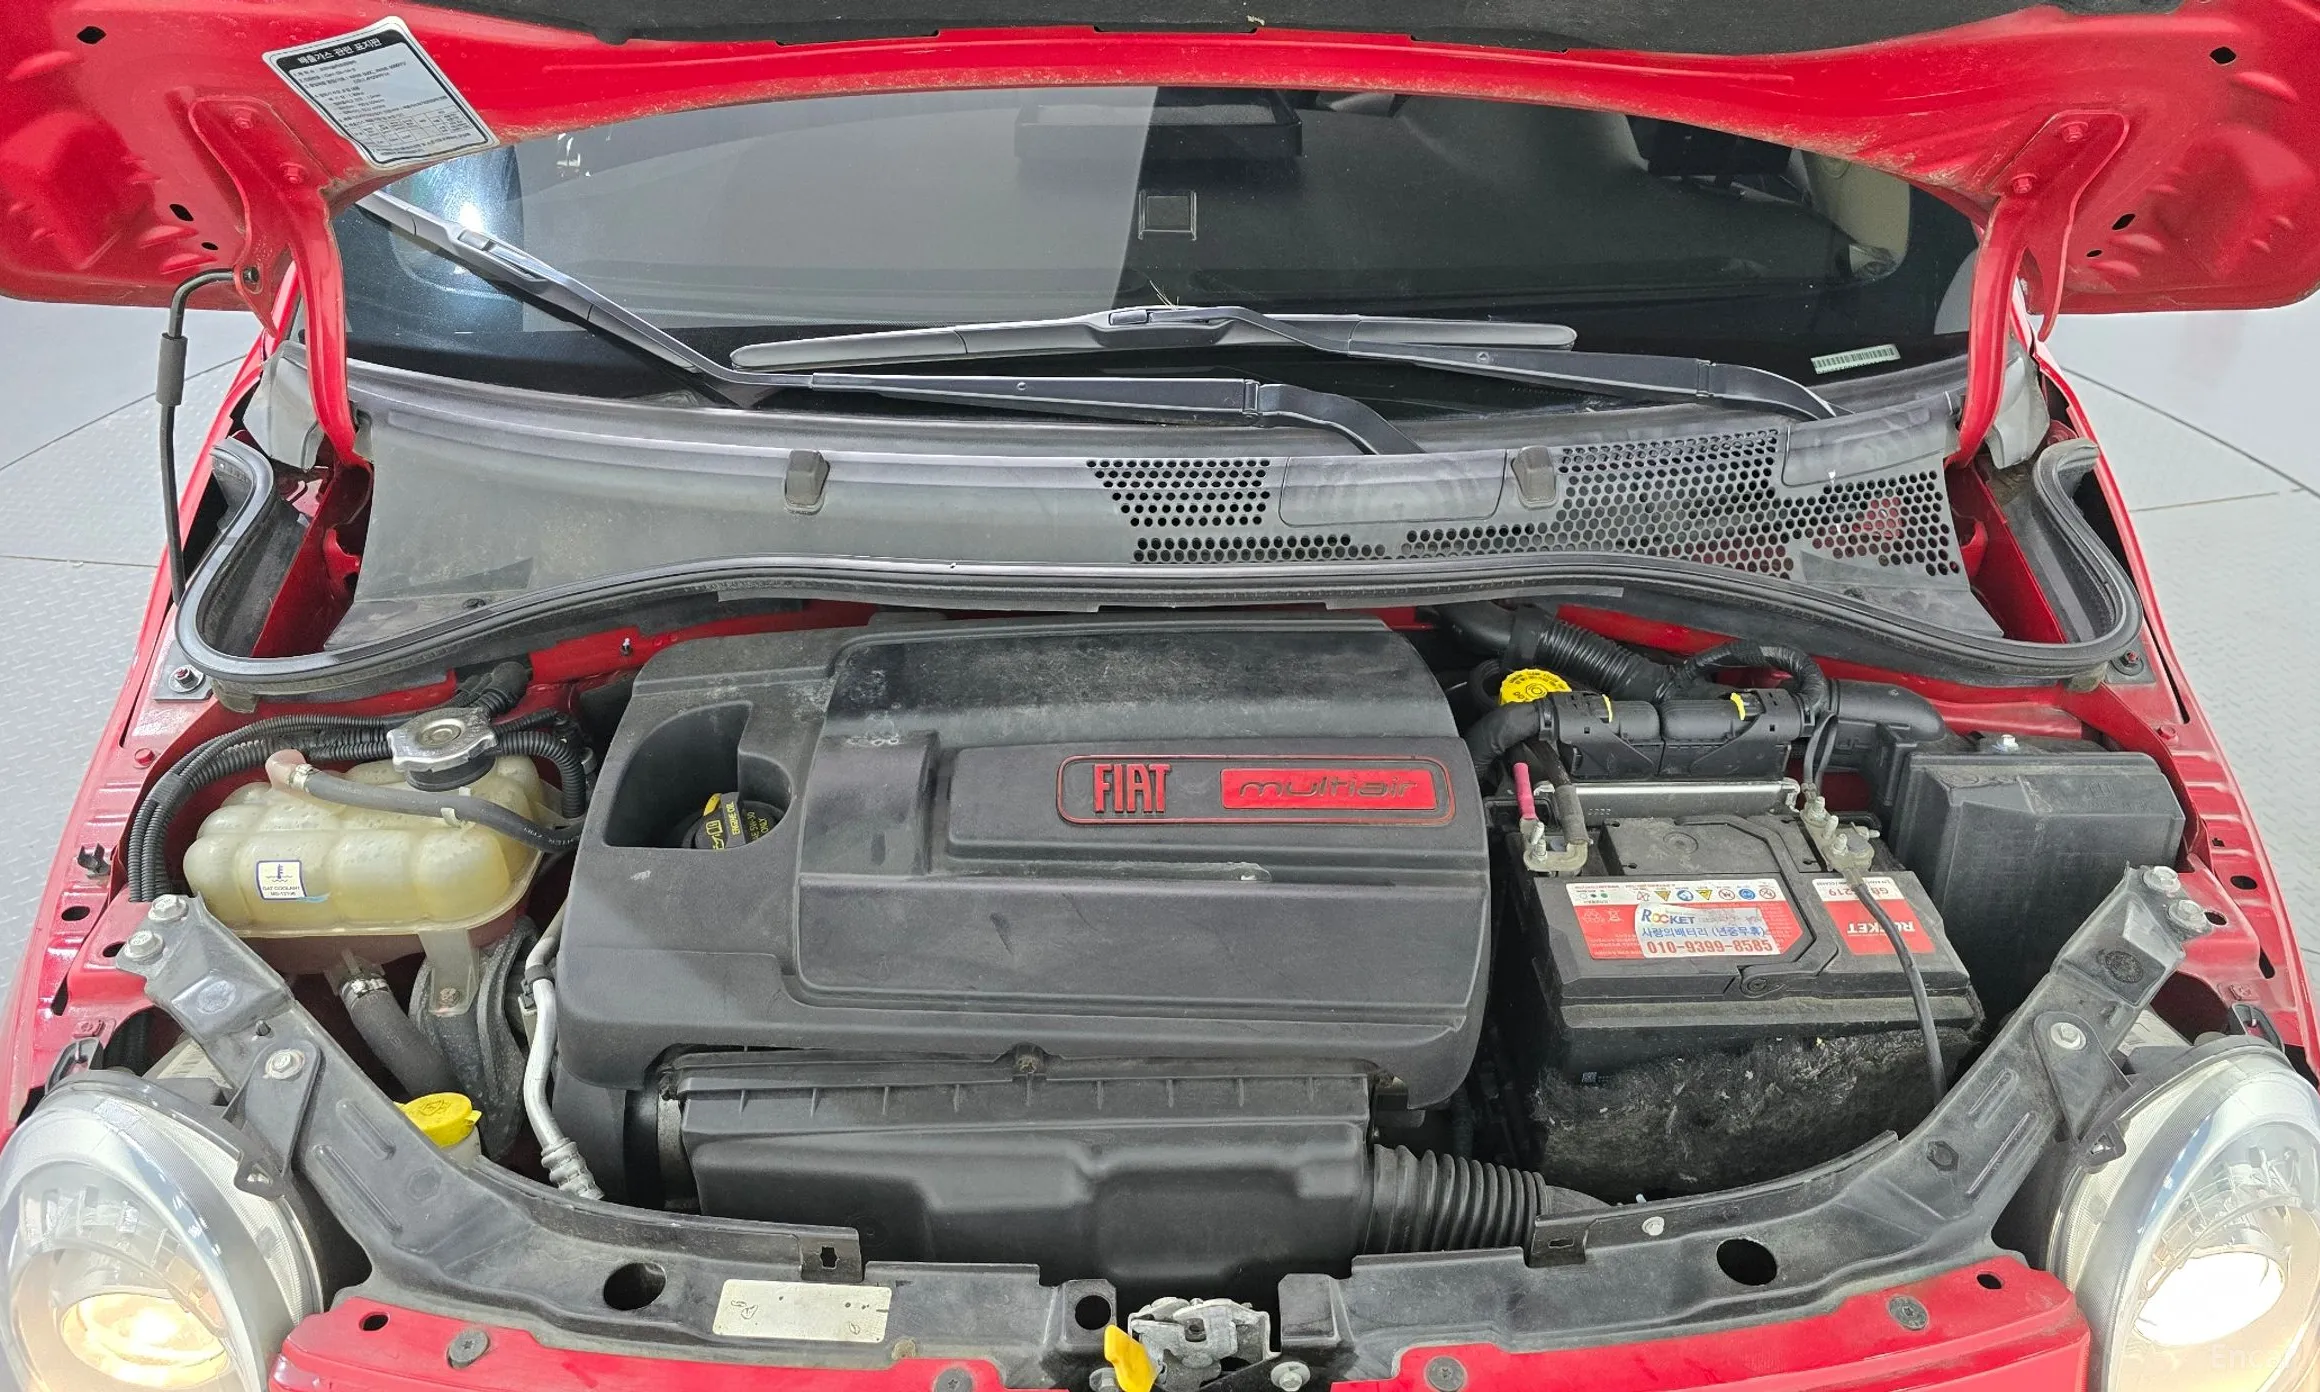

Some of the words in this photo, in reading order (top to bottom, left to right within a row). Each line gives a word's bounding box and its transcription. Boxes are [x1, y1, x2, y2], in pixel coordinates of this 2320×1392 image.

[298, 50, 334, 64] 배출가스
[333, 45, 355, 57] 관련
[355, 38, 382, 51] 표지판
[1093, 763, 1171, 813] FIAT
[1238, 776, 1420, 798] multiair
[725, 801, 736, 813] OIL
[728, 812, 741, 835] ENGINE
[758, 817, 769, 833] ONLY
[1641, 908, 1696, 925] ROCKET
[1641, 926, 1708, 938] 사랑의배터리
[1847, 921, 1916, 934] RKET
[1646, 939, 1774, 954] 010-9399-8585
